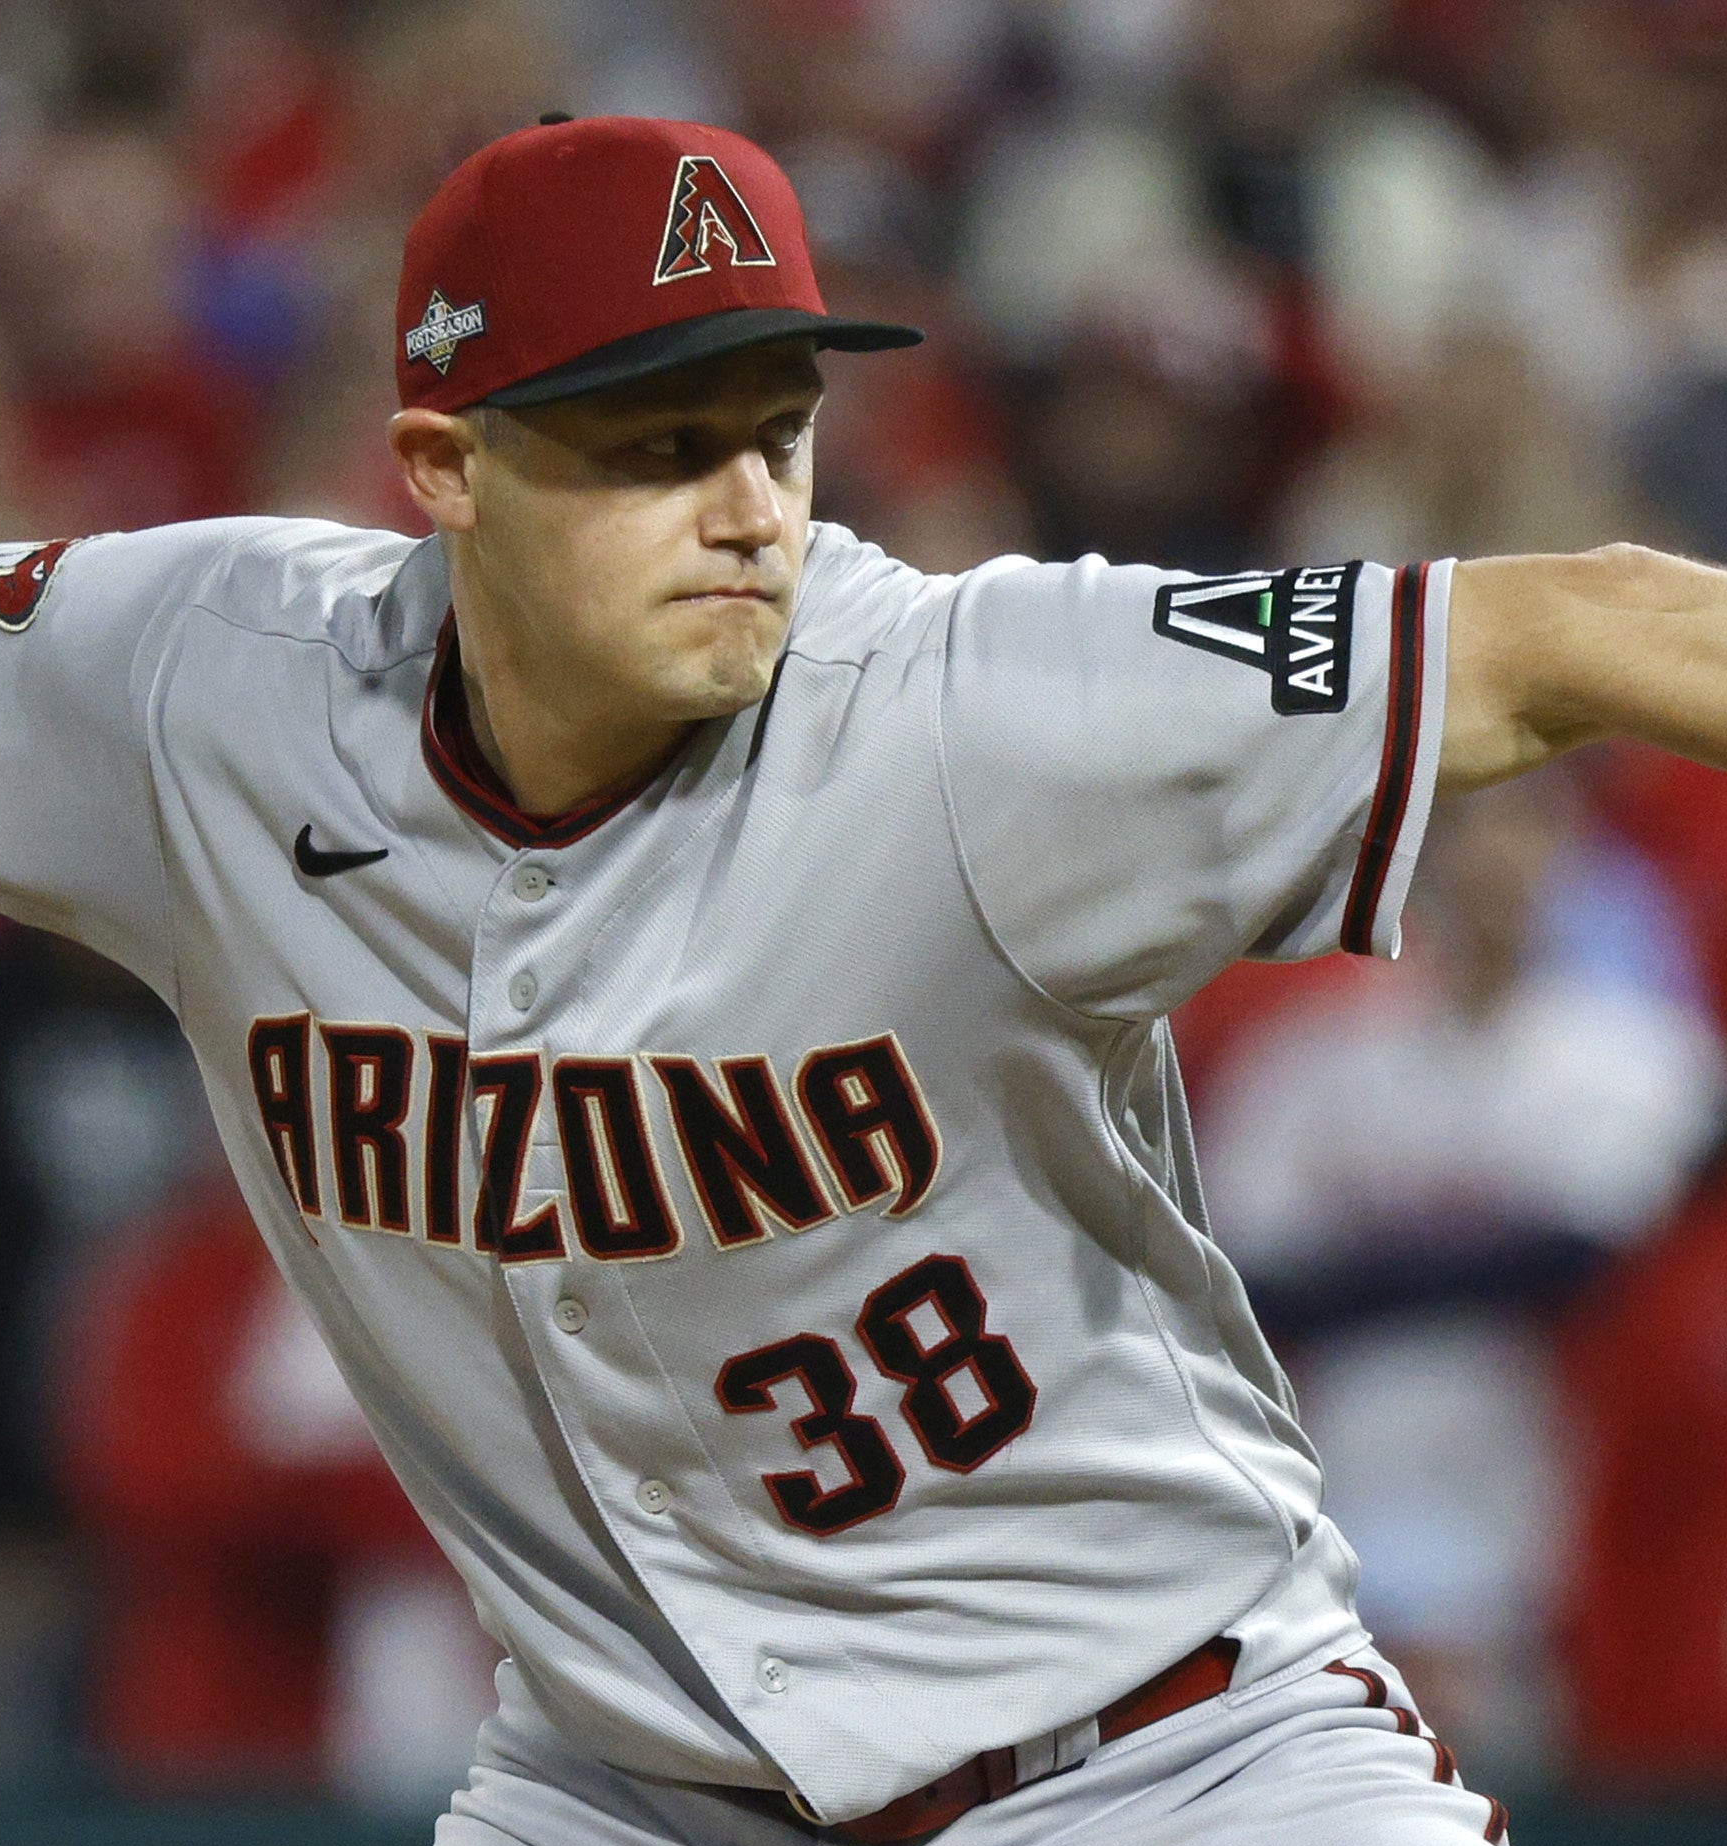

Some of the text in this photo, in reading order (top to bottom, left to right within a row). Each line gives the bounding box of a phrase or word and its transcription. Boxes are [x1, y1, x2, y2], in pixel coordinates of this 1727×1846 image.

[407, 307, 483, 354] POSTSEASON
[1289, 567, 1347, 696] AVNET
[249, 1011, 942, 1267] ARIZONA
[714, 1252, 1037, 1537] 38
